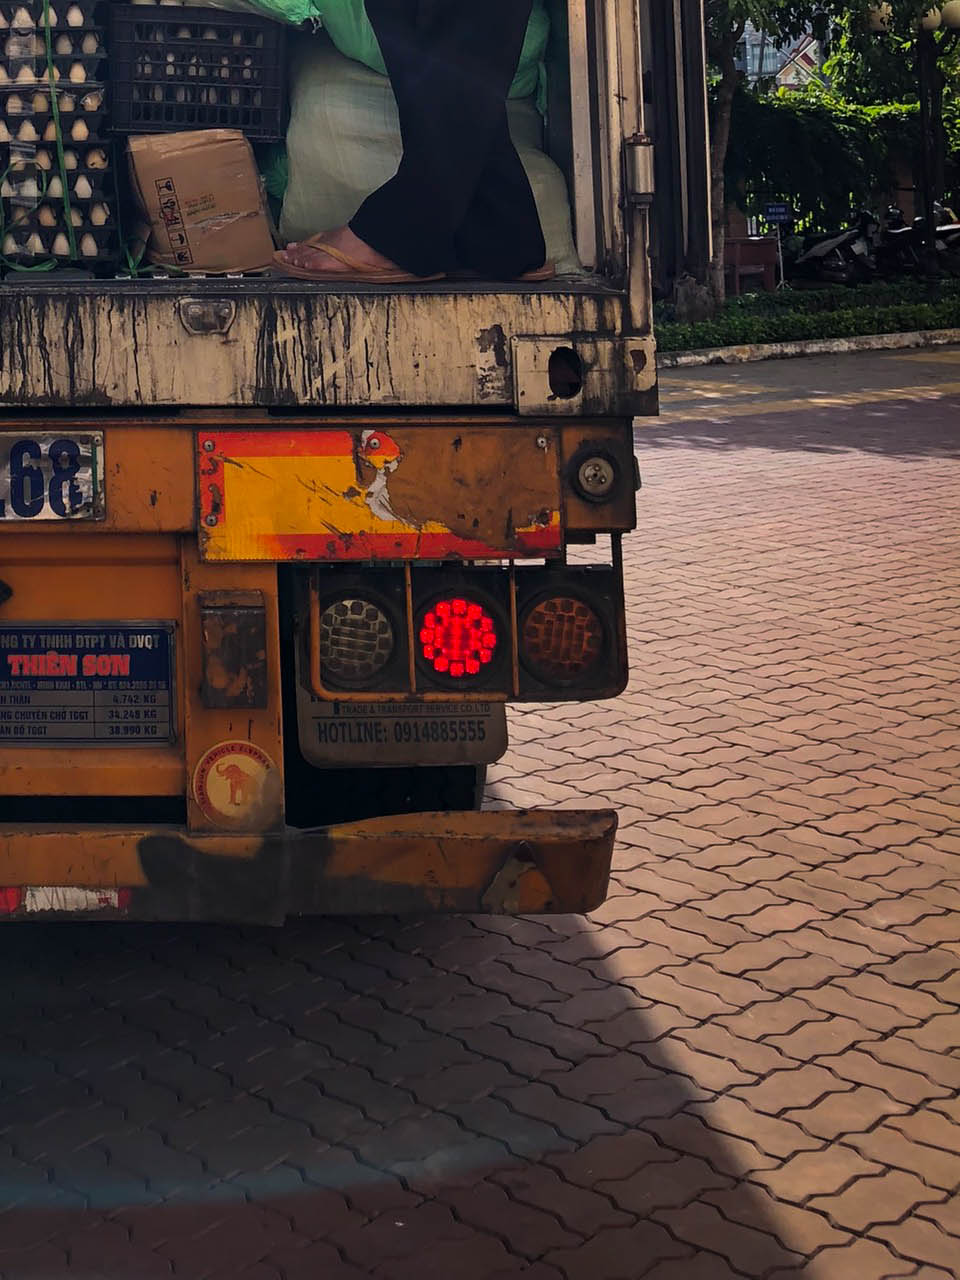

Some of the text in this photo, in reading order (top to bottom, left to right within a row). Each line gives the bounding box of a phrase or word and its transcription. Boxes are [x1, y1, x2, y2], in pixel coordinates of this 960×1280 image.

[21, 634, 36, 649] TY
[39, 634, 73, 649] TNHH
[109, 632, 126, 649] VÀ
[7, 650, 78, 677] THIÊN
[143, 694, 157, 705] KG
[143, 709, 157, 720] KG
[342, 704, 367, 714] TRADE
[143, 725, 157, 736] KG
[318, 720, 486, 745] HOTLINE: 0914885555
